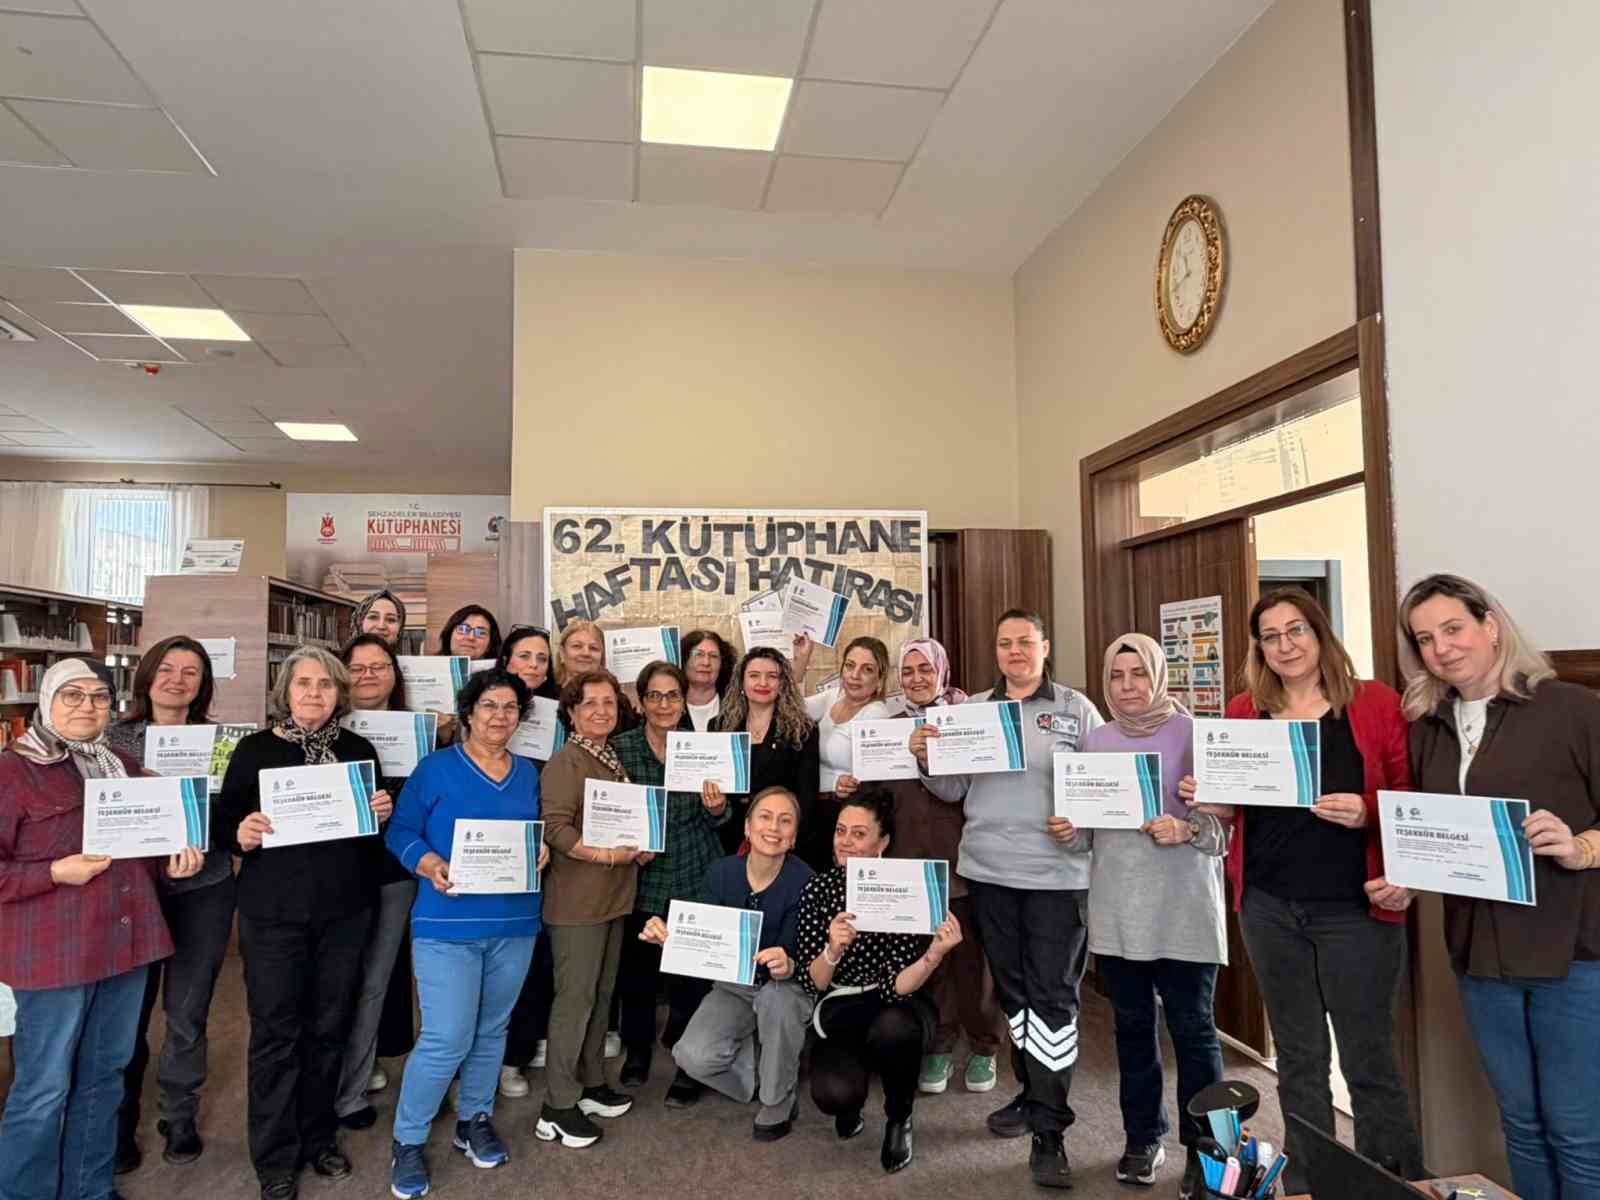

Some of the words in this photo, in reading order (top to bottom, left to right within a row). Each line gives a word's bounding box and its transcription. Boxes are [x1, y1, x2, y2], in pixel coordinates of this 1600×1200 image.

[553, 518, 625, 554] 62.
[641, 515, 921, 557] KÜTÜPHANE
[550, 556, 737, 633] HAFTASI
